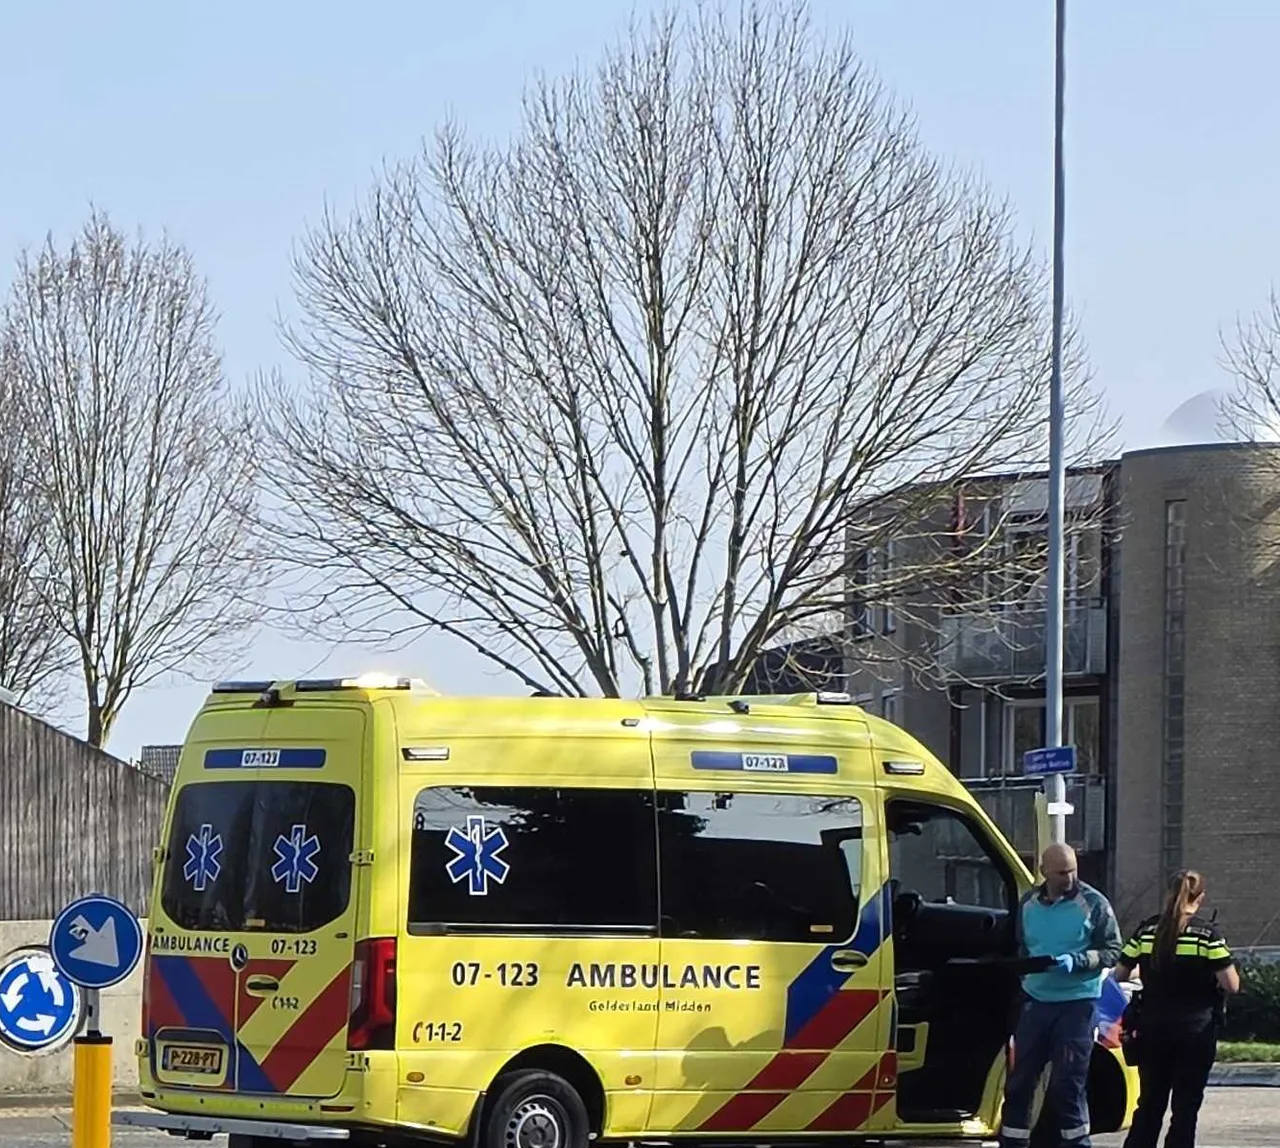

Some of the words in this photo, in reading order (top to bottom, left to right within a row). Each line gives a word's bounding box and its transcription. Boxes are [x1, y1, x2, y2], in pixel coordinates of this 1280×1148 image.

[243, 752, 279, 765] 07-123
[152, 935, 230, 952] AMBULANCE
[271, 939, 317, 955] 07-123
[452, 961, 539, 987] 07-123
[566, 962, 761, 990] AMBULANCE
[589, 1000, 660, 1012] Gelderland
[665, 1001, 712, 1013] Midden
[425, 1022, 462, 1042] 1-1-2
